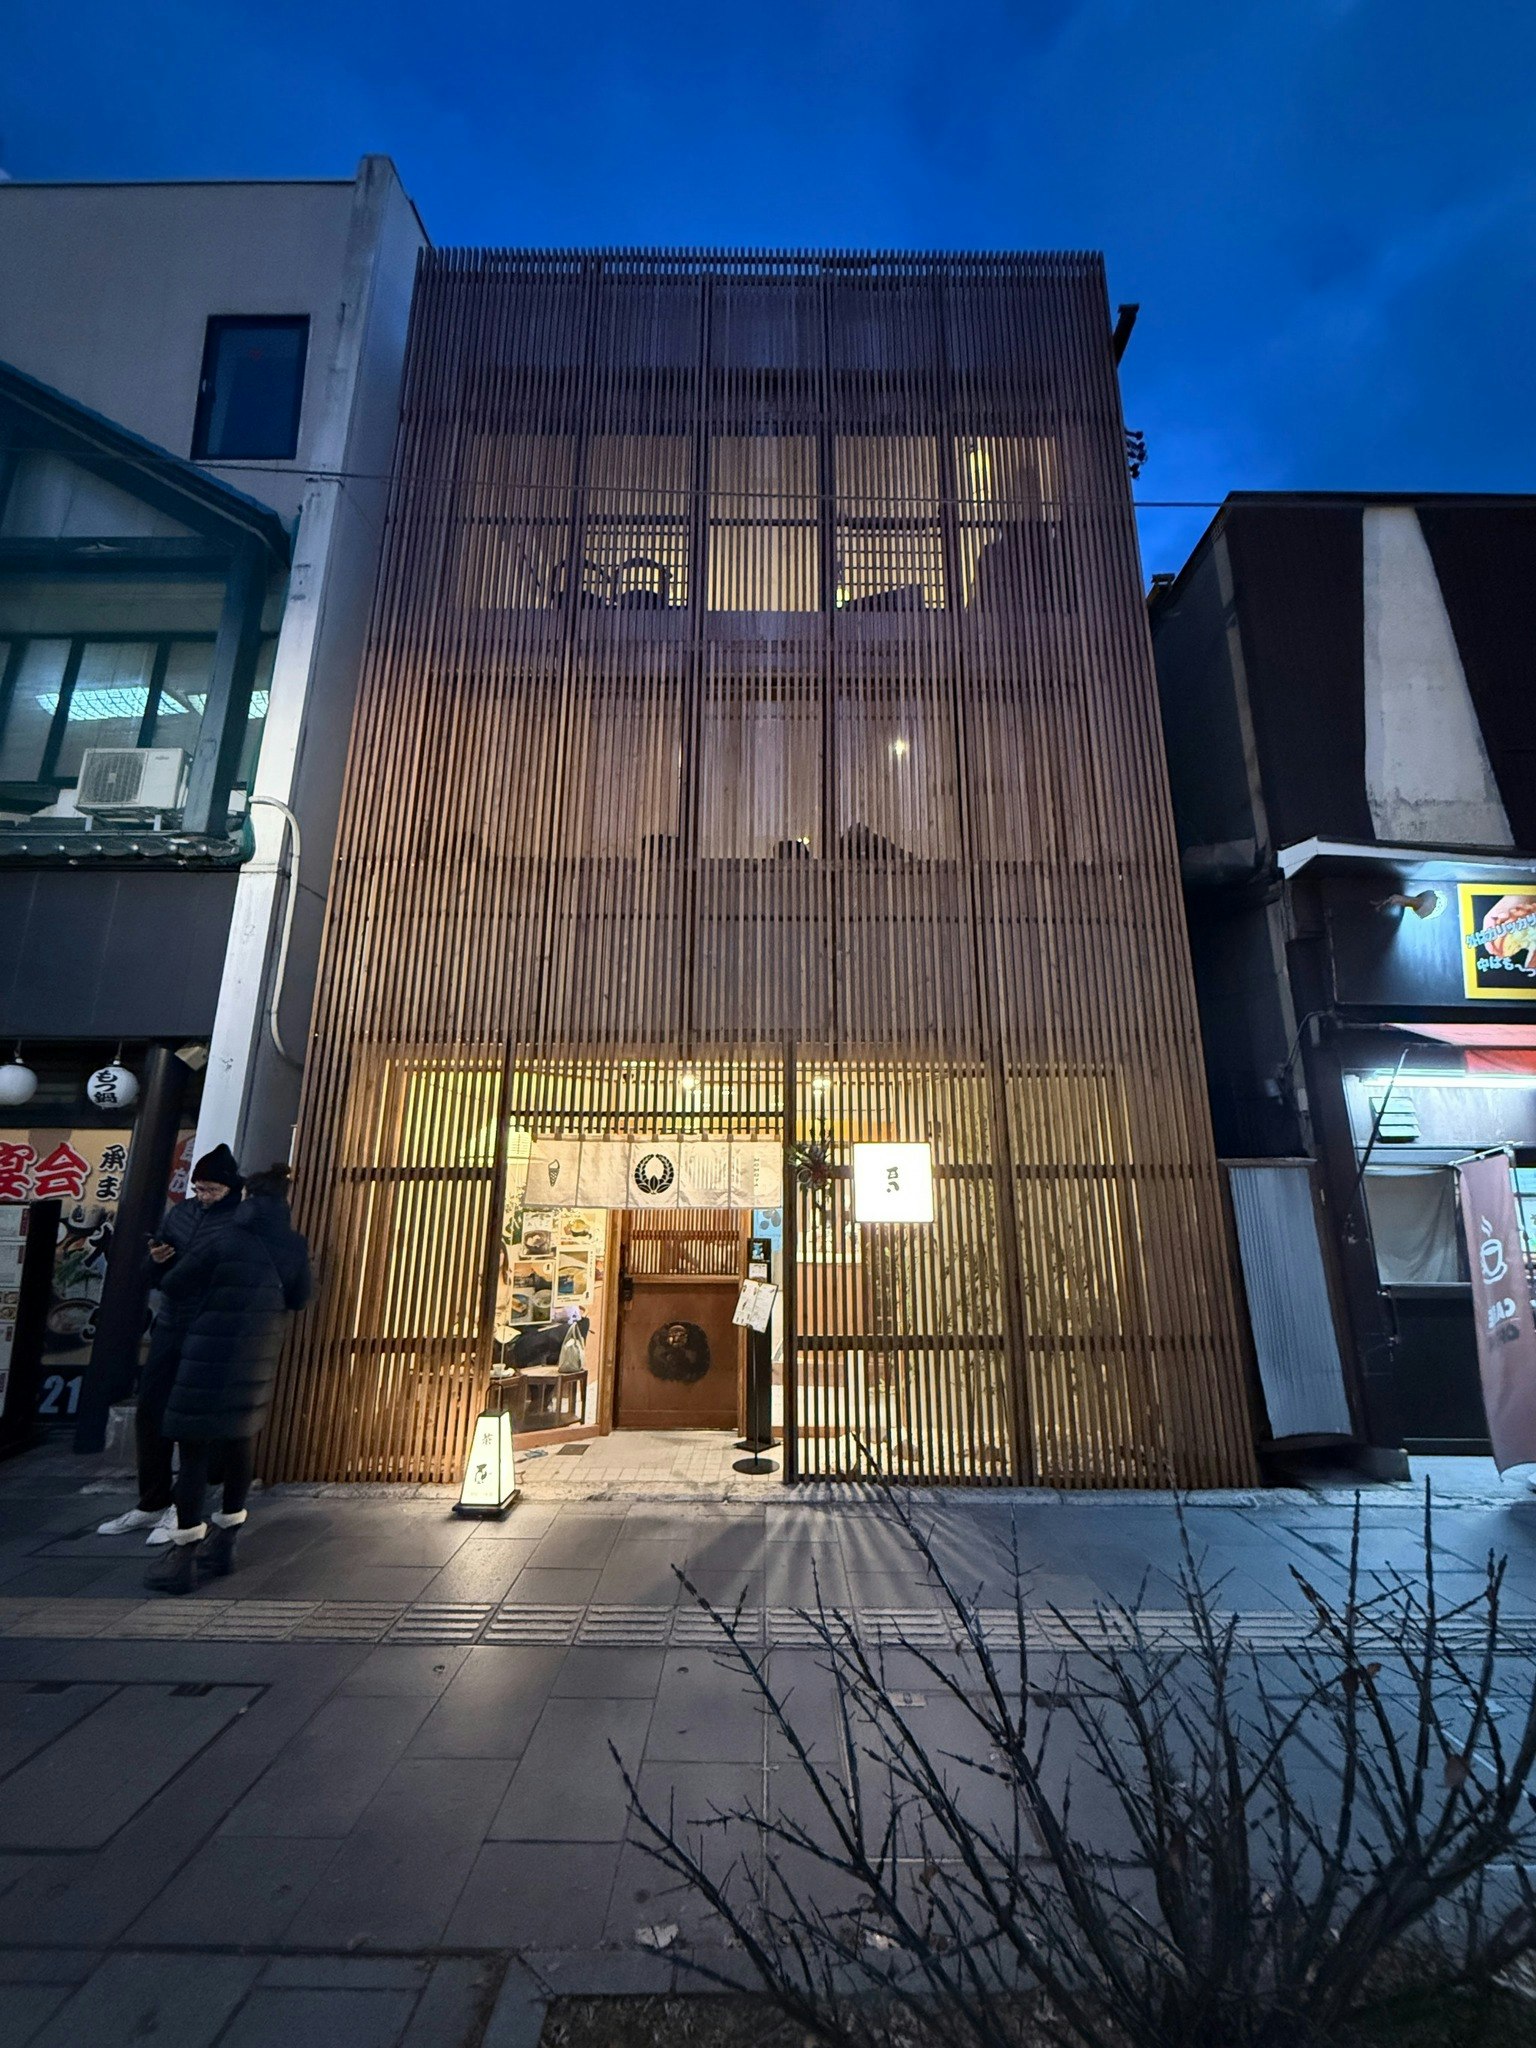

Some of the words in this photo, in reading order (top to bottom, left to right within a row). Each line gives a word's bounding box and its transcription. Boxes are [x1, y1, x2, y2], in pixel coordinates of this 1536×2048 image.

[94, 1070, 118, 1103] もつ鍋
[0, 1142, 89, 1198] 宴会
[38, 1375, 83, 1414] 21
